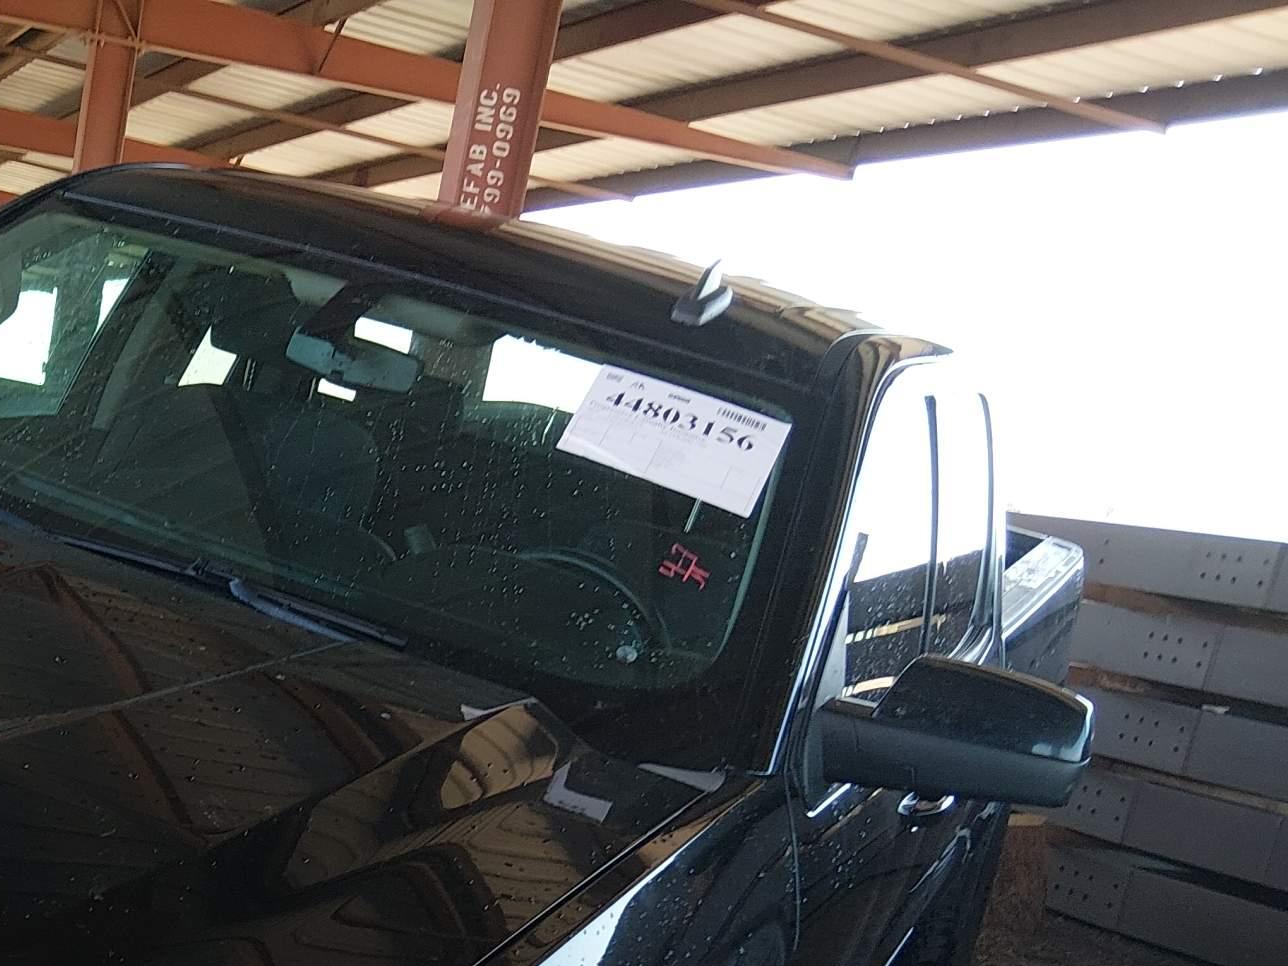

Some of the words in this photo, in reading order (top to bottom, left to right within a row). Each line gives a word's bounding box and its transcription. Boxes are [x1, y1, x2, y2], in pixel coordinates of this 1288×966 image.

[460, 143, 487, 211] EFAB
[474, 83, 501, 132] INC.
[606, 392, 755, 452] 44803156
